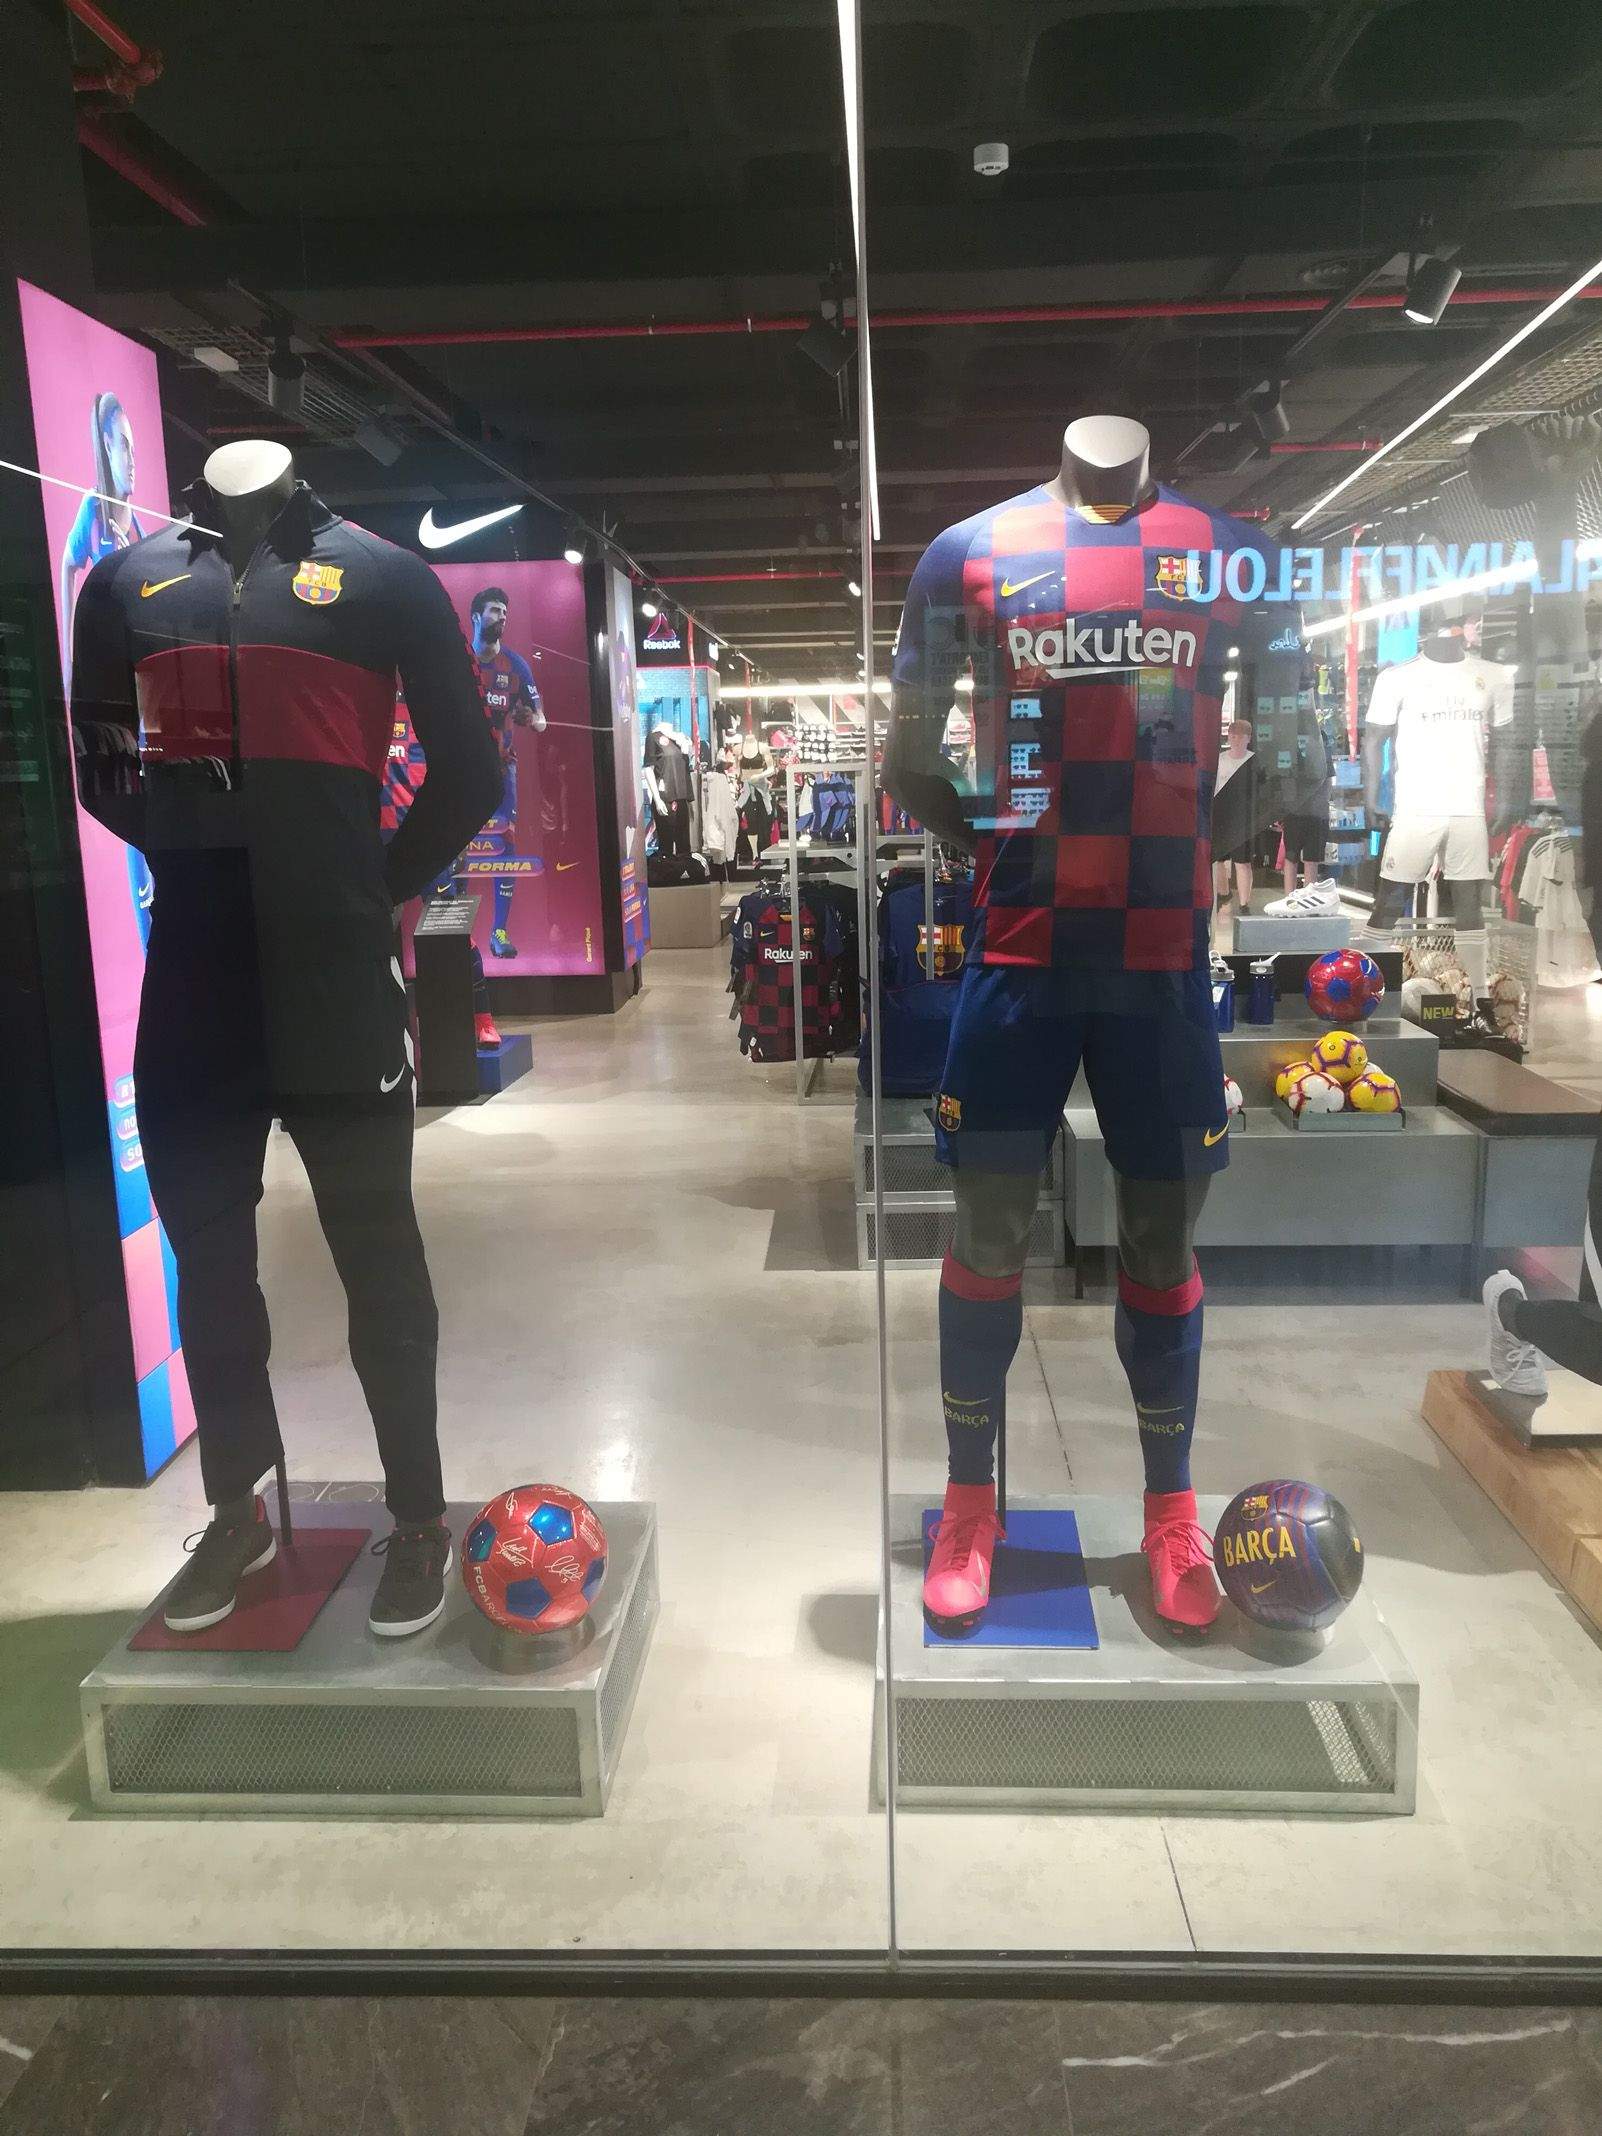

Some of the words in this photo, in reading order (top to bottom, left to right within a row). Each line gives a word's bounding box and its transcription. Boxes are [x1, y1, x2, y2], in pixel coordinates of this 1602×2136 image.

[1007, 618, 1197, 671] Rakuten
[467, 861, 532, 872] FORMA
[764, 948, 813, 960] Rakuen
[1423, 1006, 1455, 1020] NEW
[944, 1405, 989, 1429] BARÇA
[1223, 1526, 1297, 1567] BARÇA
